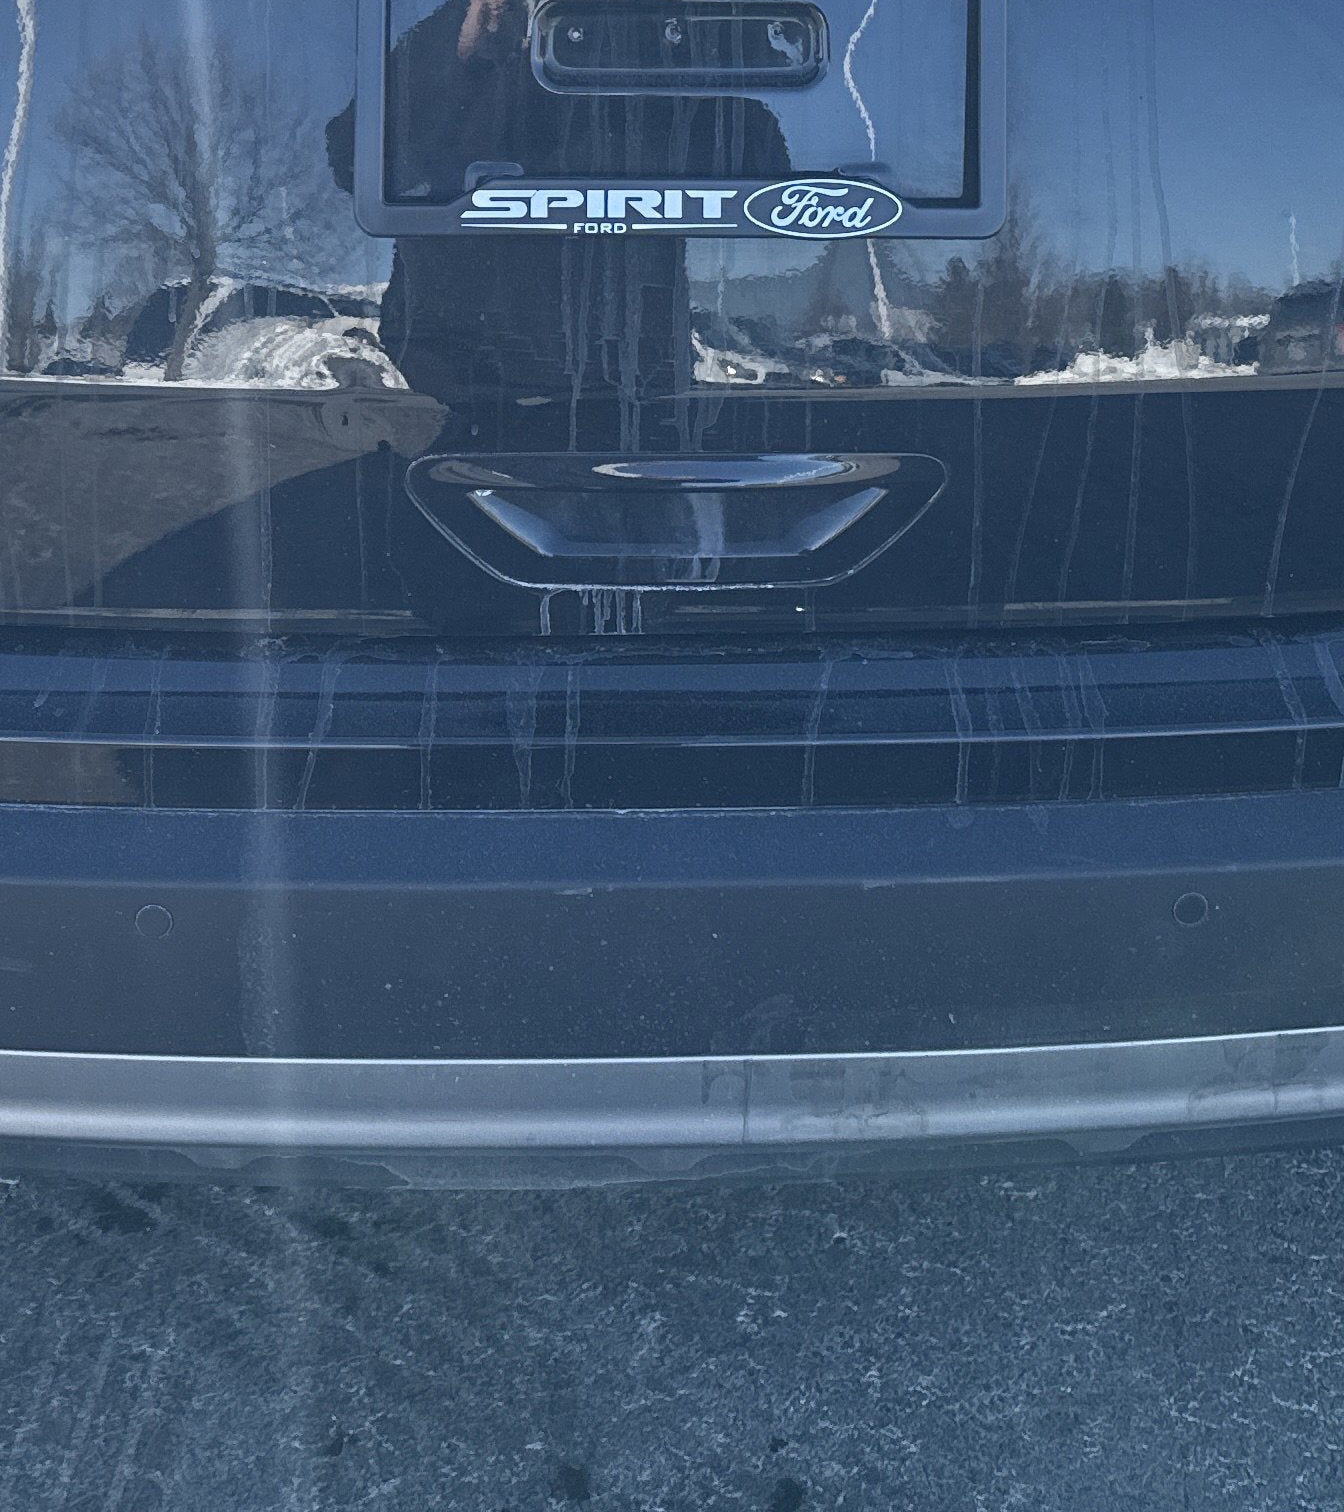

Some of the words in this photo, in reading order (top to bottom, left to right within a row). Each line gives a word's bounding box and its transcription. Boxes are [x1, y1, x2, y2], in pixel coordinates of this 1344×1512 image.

[460, 189, 739, 219] SPIRIT
[770, 184, 875, 230] Ford
[573, 223, 627, 234] FORD
